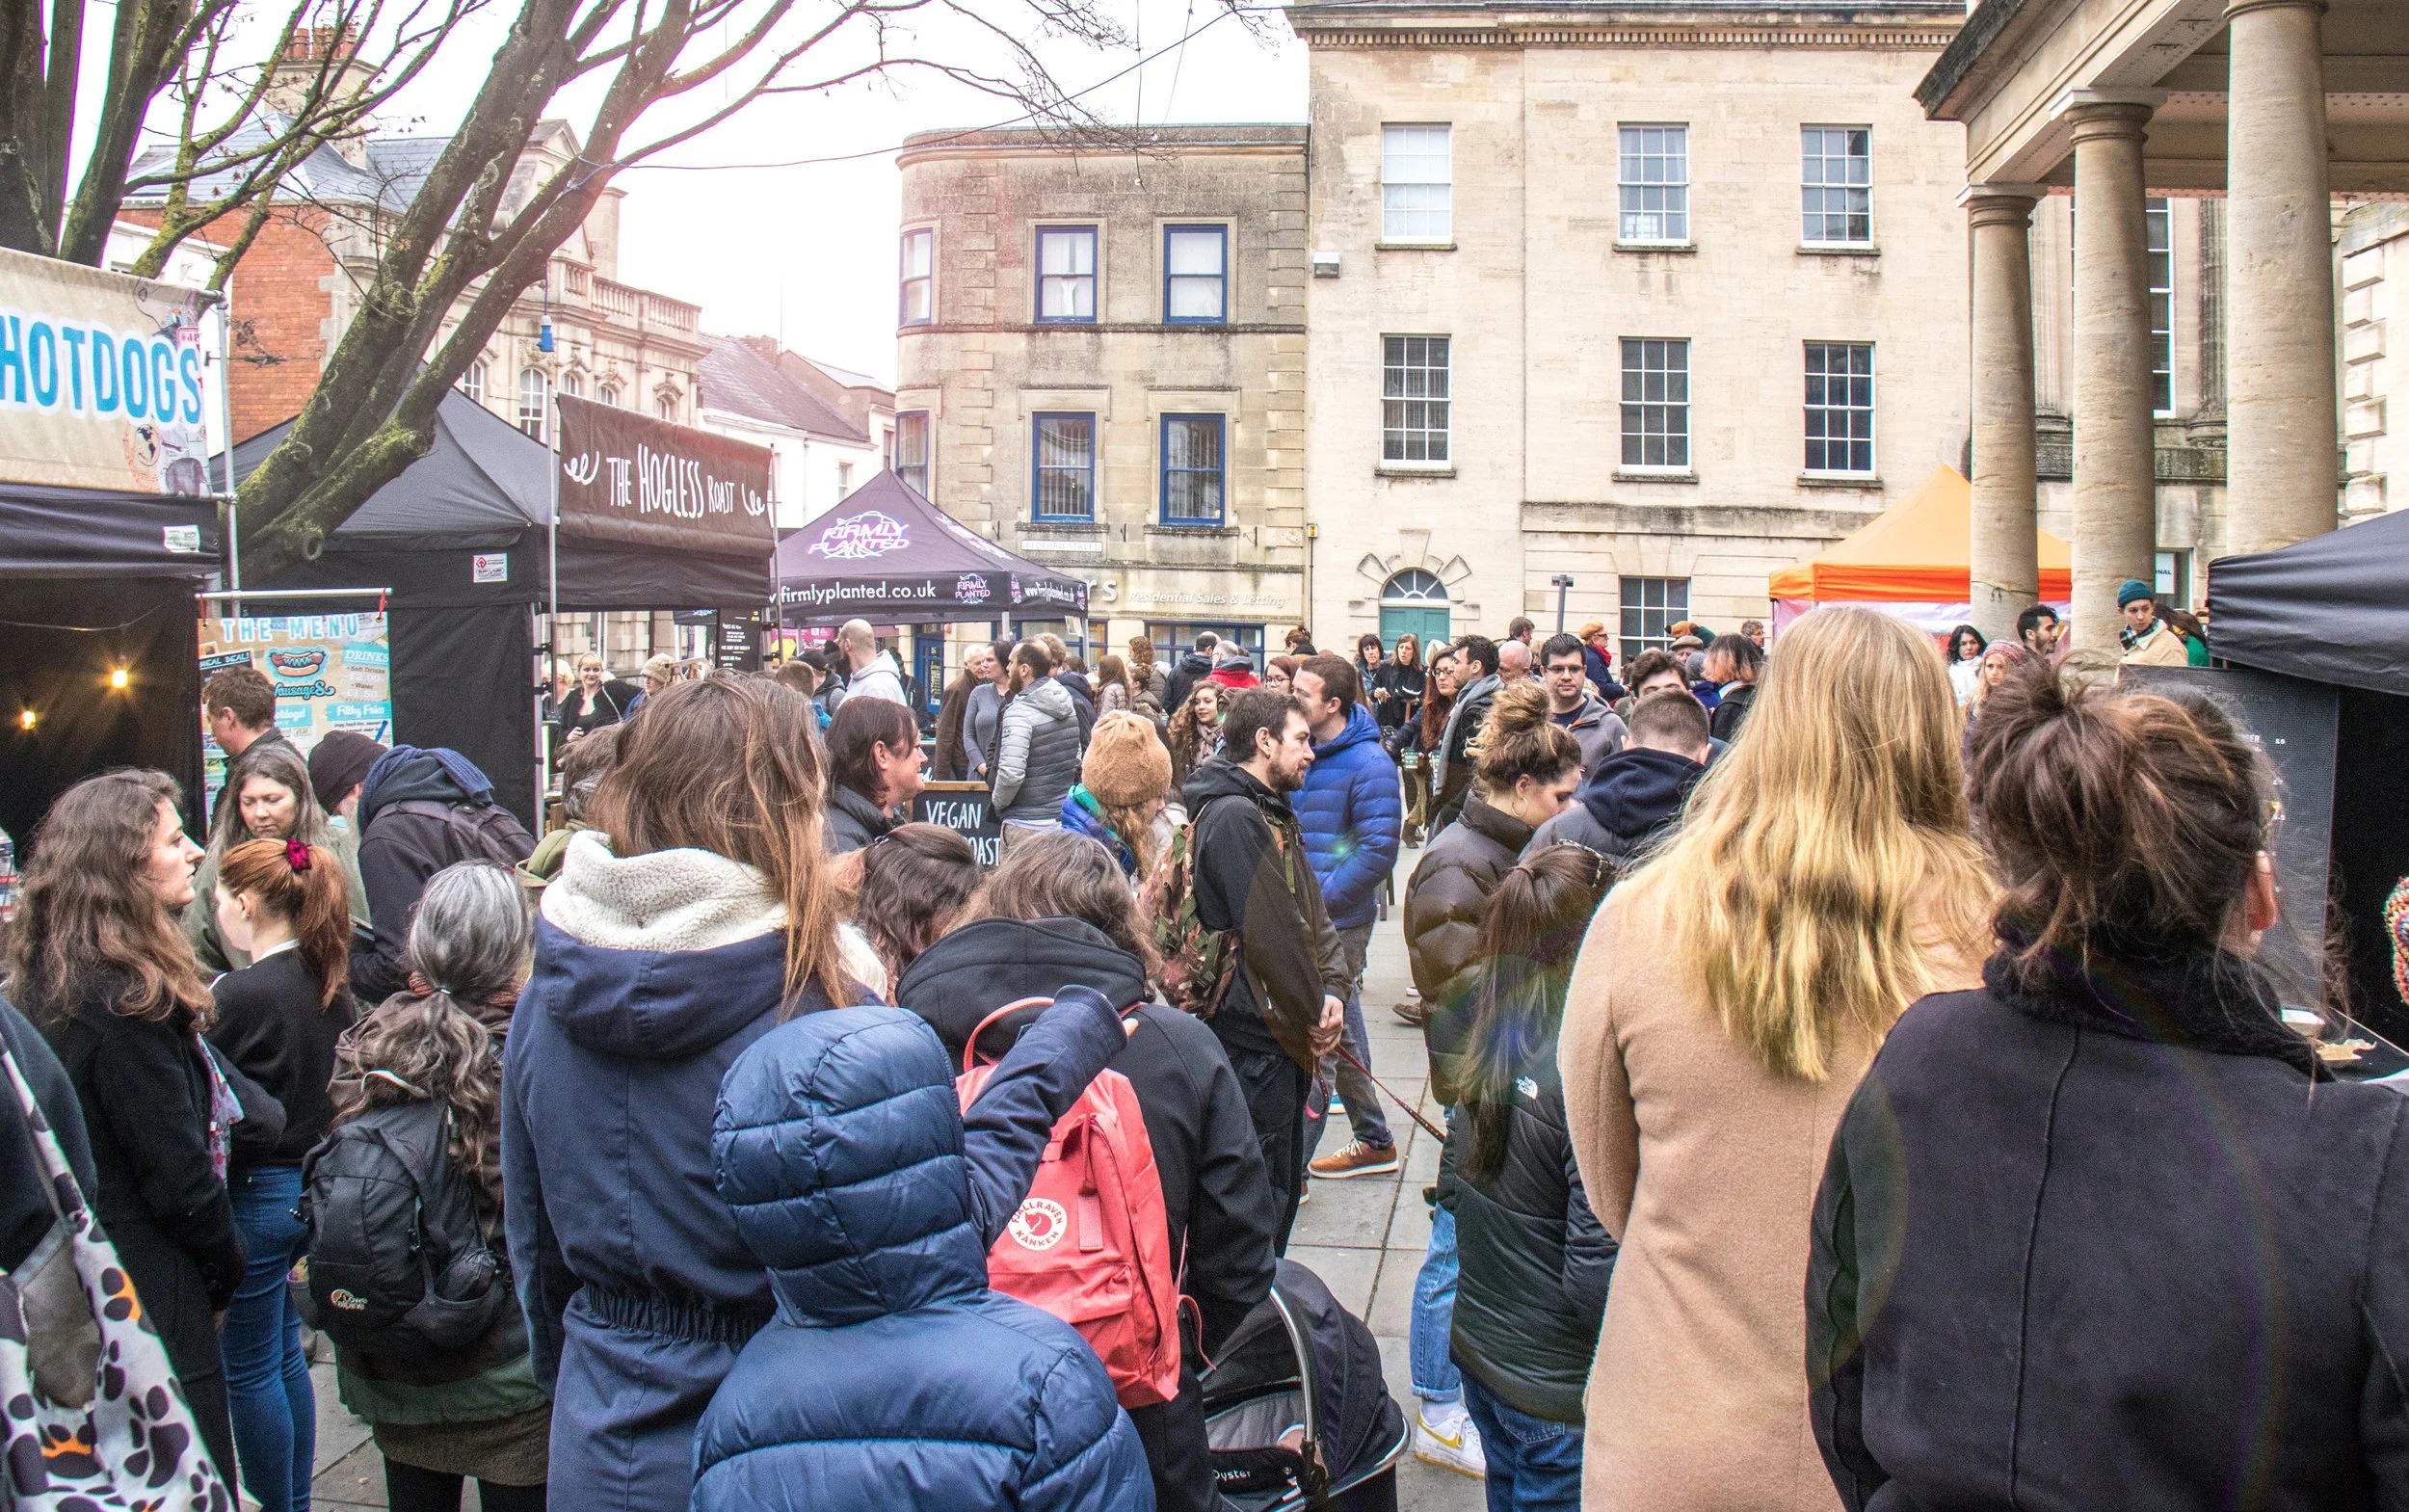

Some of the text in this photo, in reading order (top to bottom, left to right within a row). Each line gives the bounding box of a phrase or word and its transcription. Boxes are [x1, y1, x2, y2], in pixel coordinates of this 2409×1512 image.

[0, 315, 201, 424] HOTDOGS
[606, 443, 735, 518] THE HOGLESS ROAST
[821, 523, 910, 542] FIRMLY
[807, 539, 910, 554] PLANTED
[1069, 543, 1099, 551] STREET
[955, 589, 991, 598] PLANTED
[957, 579, 987, 591] FIRMLY
[1084, 579, 1118, 601] rs
[1129, 591, 1193, 603] Residential
[1196, 593, 1226, 604] Sales
[1230, 594, 1238, 605] &
[221, 613, 360, 644] THE MENU
[345, 650, 389, 663] DRINKS
[925, 800, 982, 830] VEGAN
[965, 836, 1000, 866] OAST
